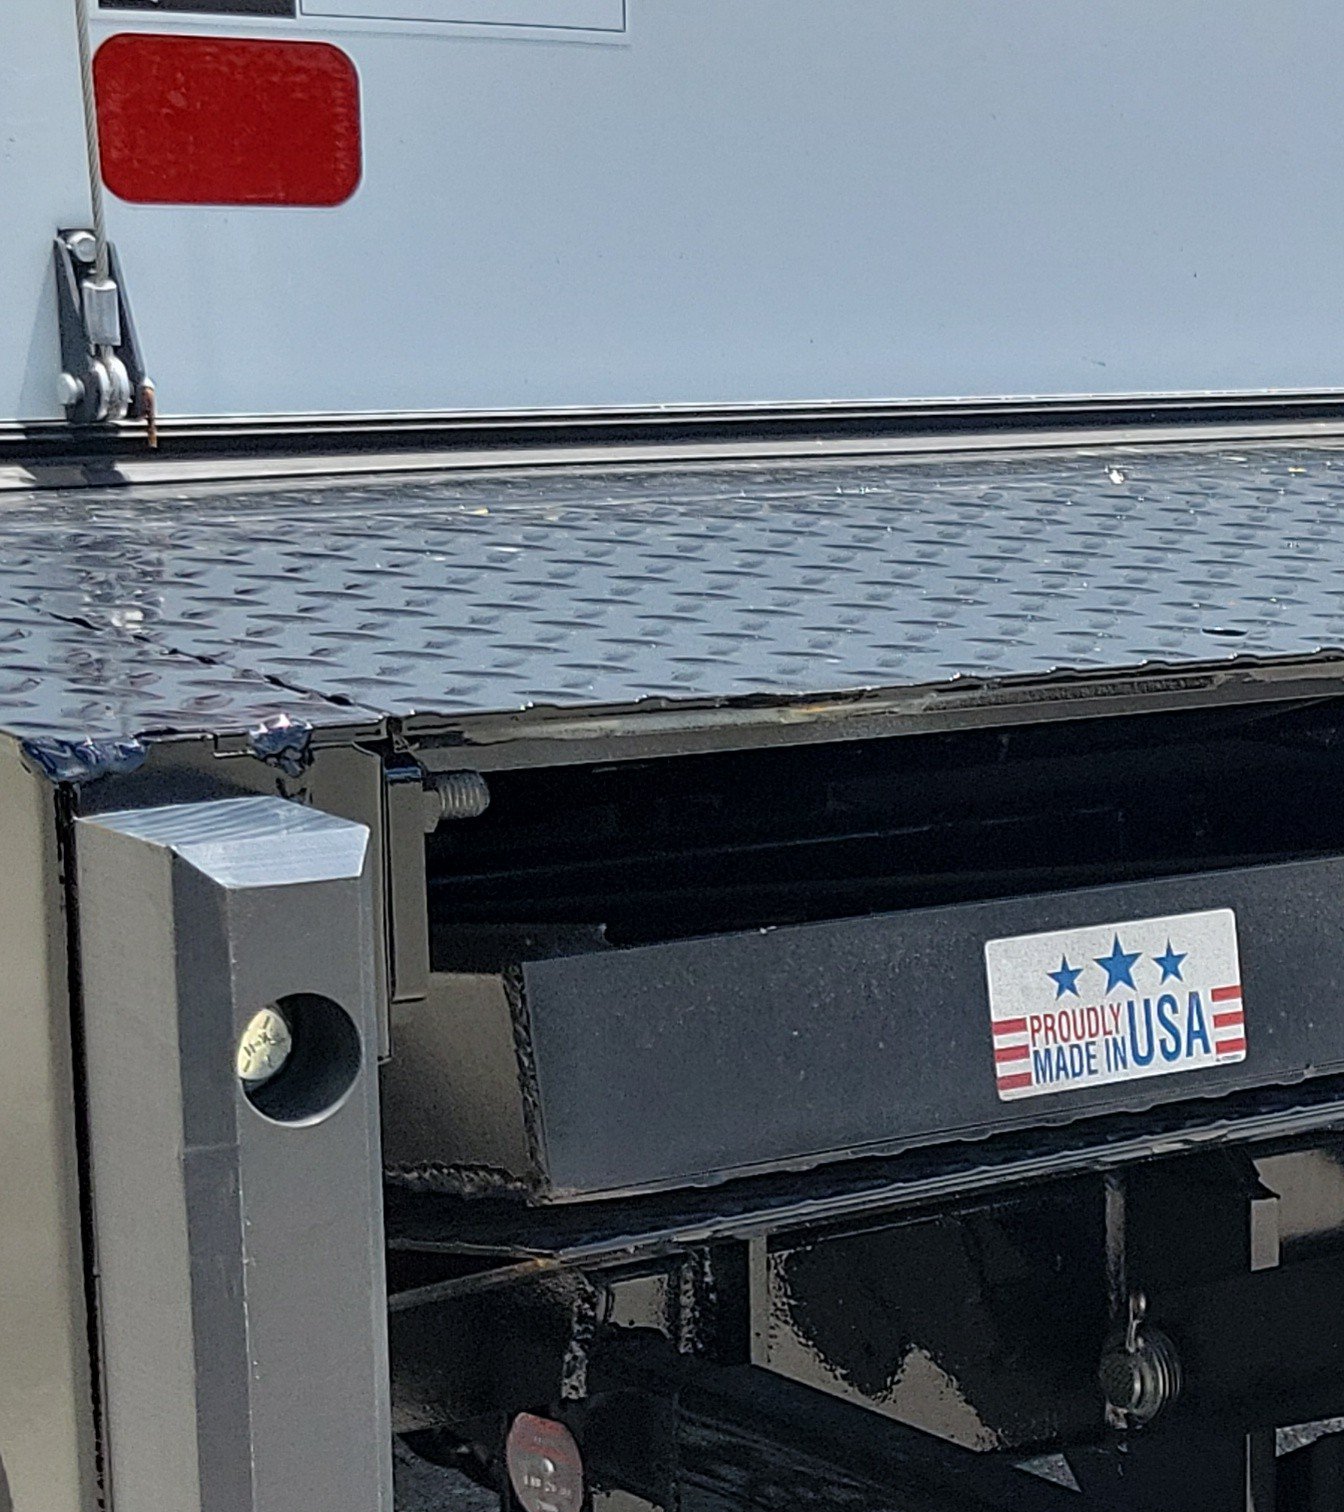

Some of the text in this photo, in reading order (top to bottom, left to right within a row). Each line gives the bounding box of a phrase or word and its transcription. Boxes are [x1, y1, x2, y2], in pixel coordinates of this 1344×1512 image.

[1029, 1002, 1122, 1048] PROUDLY
[1032, 990, 1211, 1085] MADE IN USA
